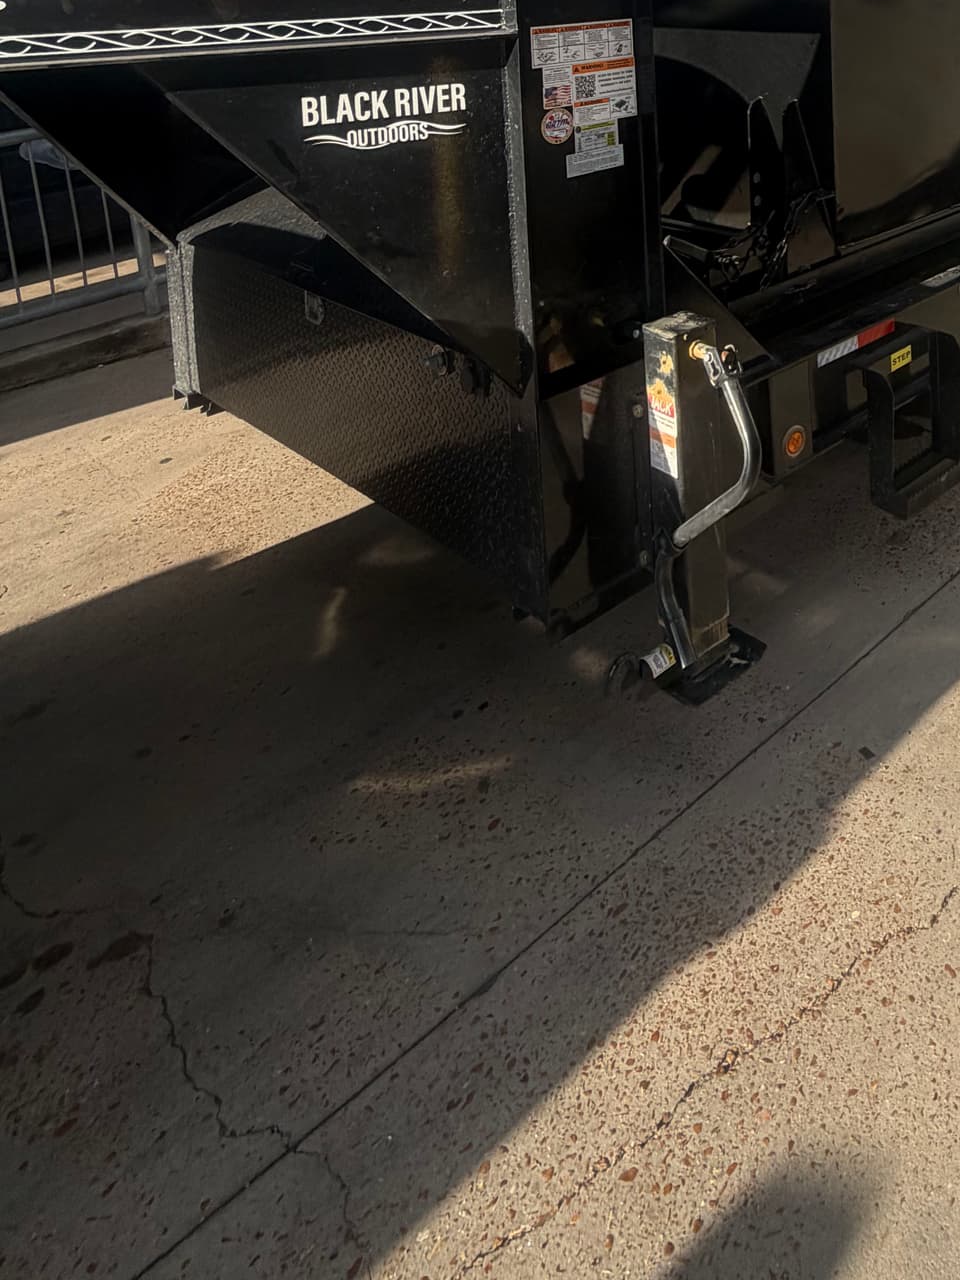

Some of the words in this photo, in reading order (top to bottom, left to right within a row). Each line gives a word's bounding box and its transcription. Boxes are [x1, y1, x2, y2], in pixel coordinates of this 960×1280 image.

[301, 90, 390, 127] BLACK
[394, 83, 467, 117] RIVER
[346, 122, 429, 147] OUTDOORS
[891, 349, 911, 365] STEP
